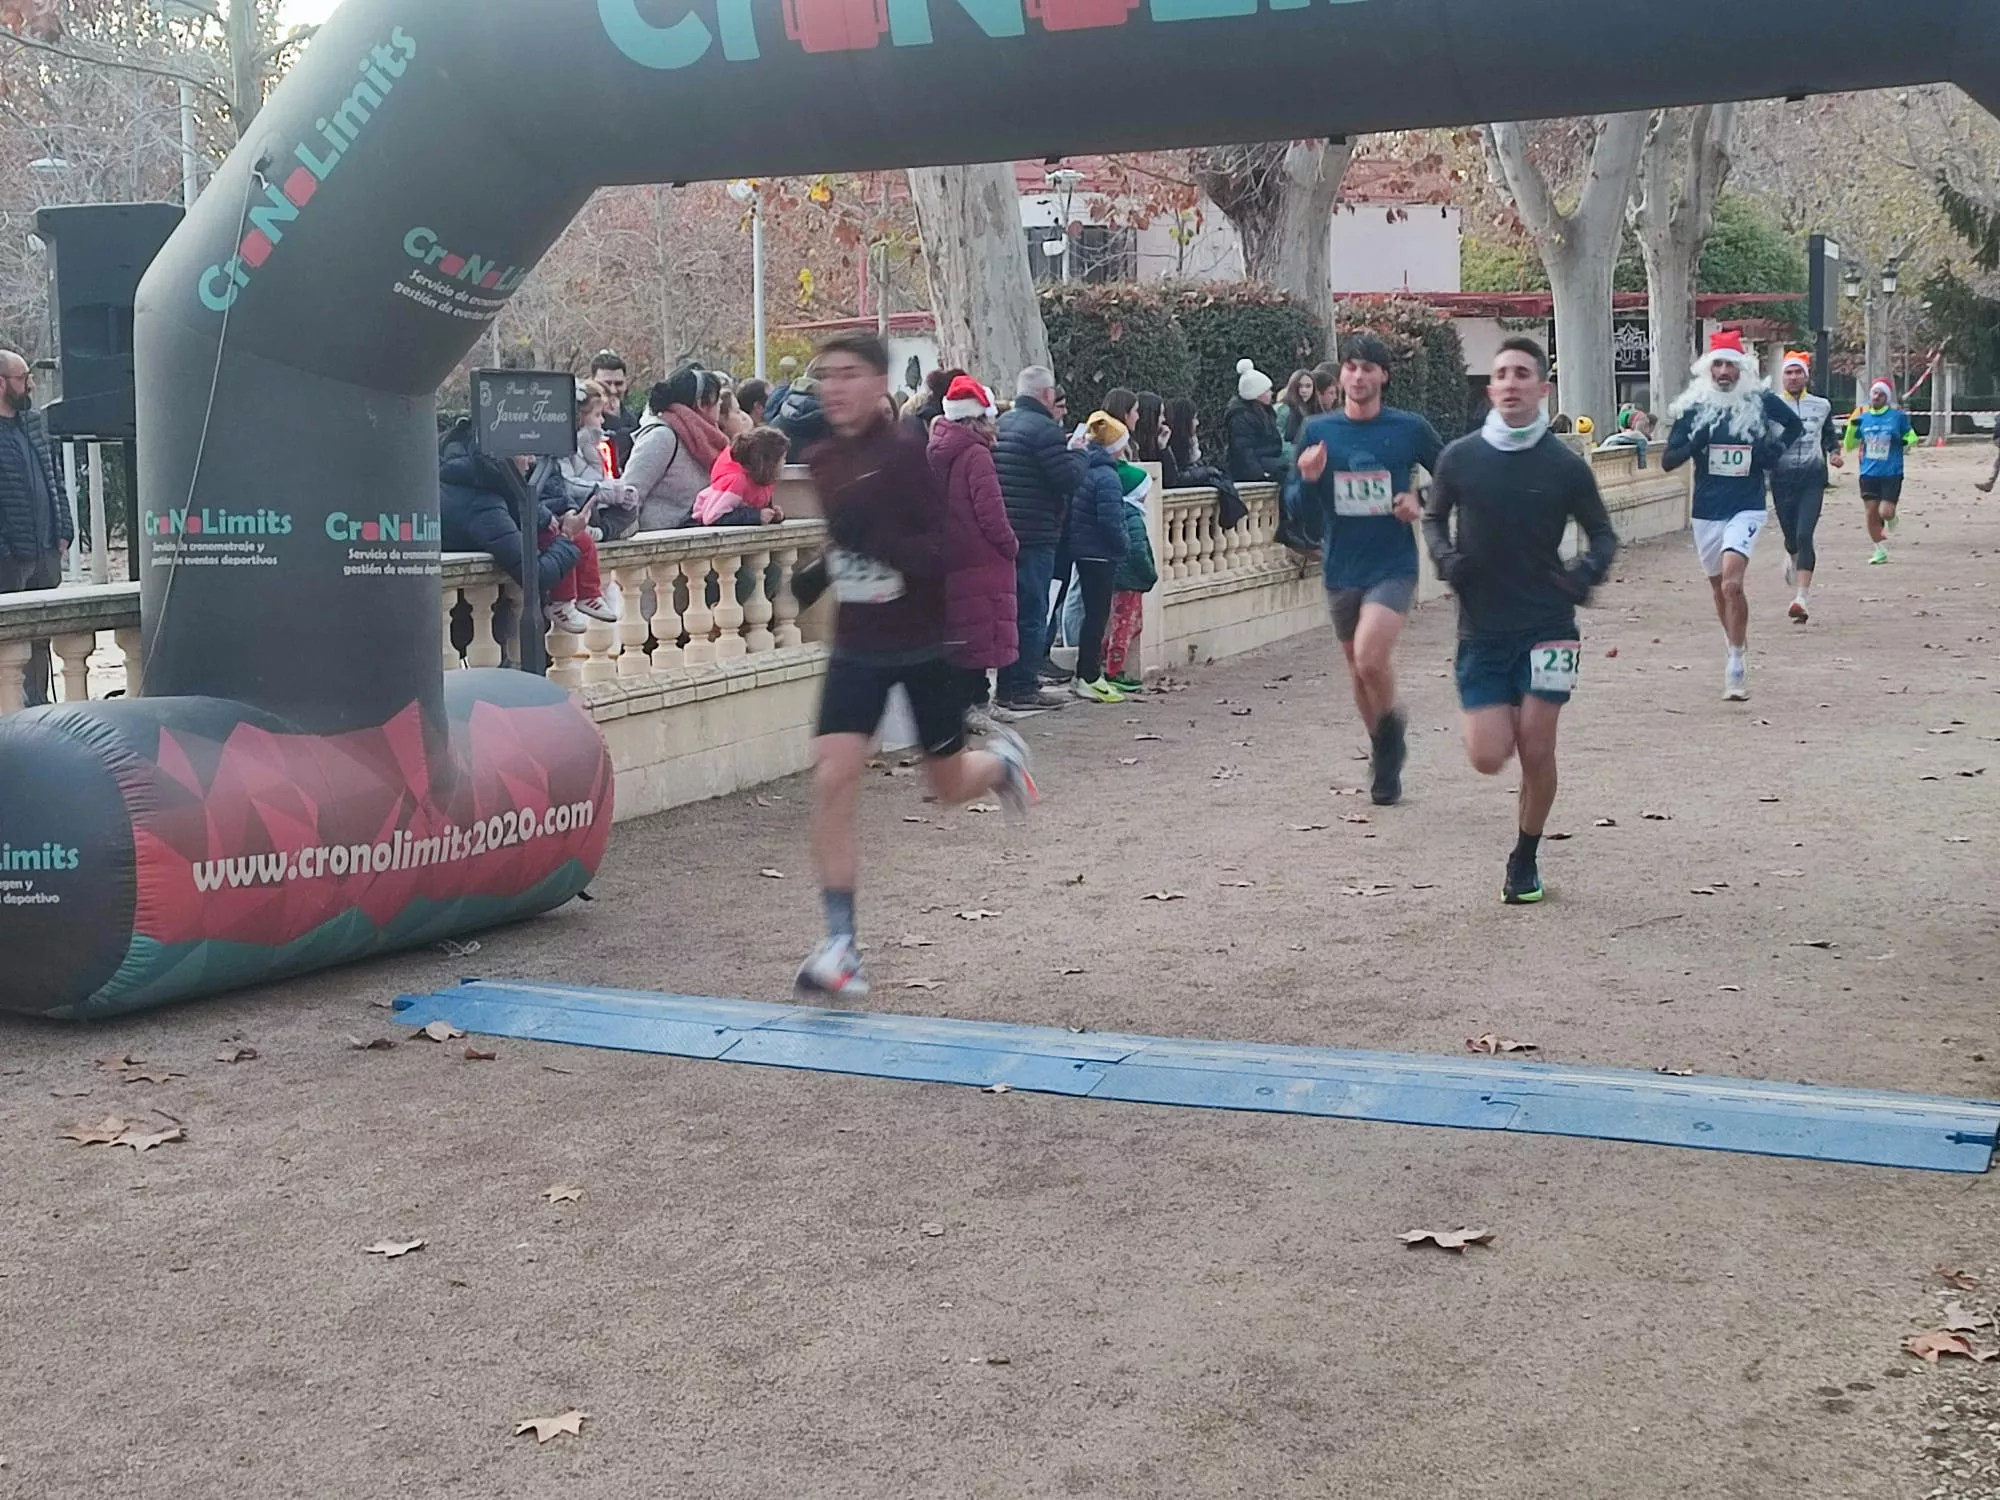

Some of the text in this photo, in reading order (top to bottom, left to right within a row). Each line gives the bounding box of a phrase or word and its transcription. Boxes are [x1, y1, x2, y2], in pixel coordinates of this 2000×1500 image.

[409, 269, 454, 297] Servicio
[393, 281, 437, 309] gestión
[1722, 450, 1743, 465] 10
[1345, 479, 1385, 500] 135
[189, 541, 256, 553] cronometraje
[256, 542, 265, 553] y
[348, 548, 387, 560] Servicio
[389, 548, 401, 560] de
[221, 554, 278, 567] deportivos
[343, 563, 382, 576] gestión
[1544, 648, 1580, 674] 23
[193, 799, 594, 892] www.cronolimits2020.com
[25, 880, 33, 891] y
[3, 892, 61, 906] deportivo
